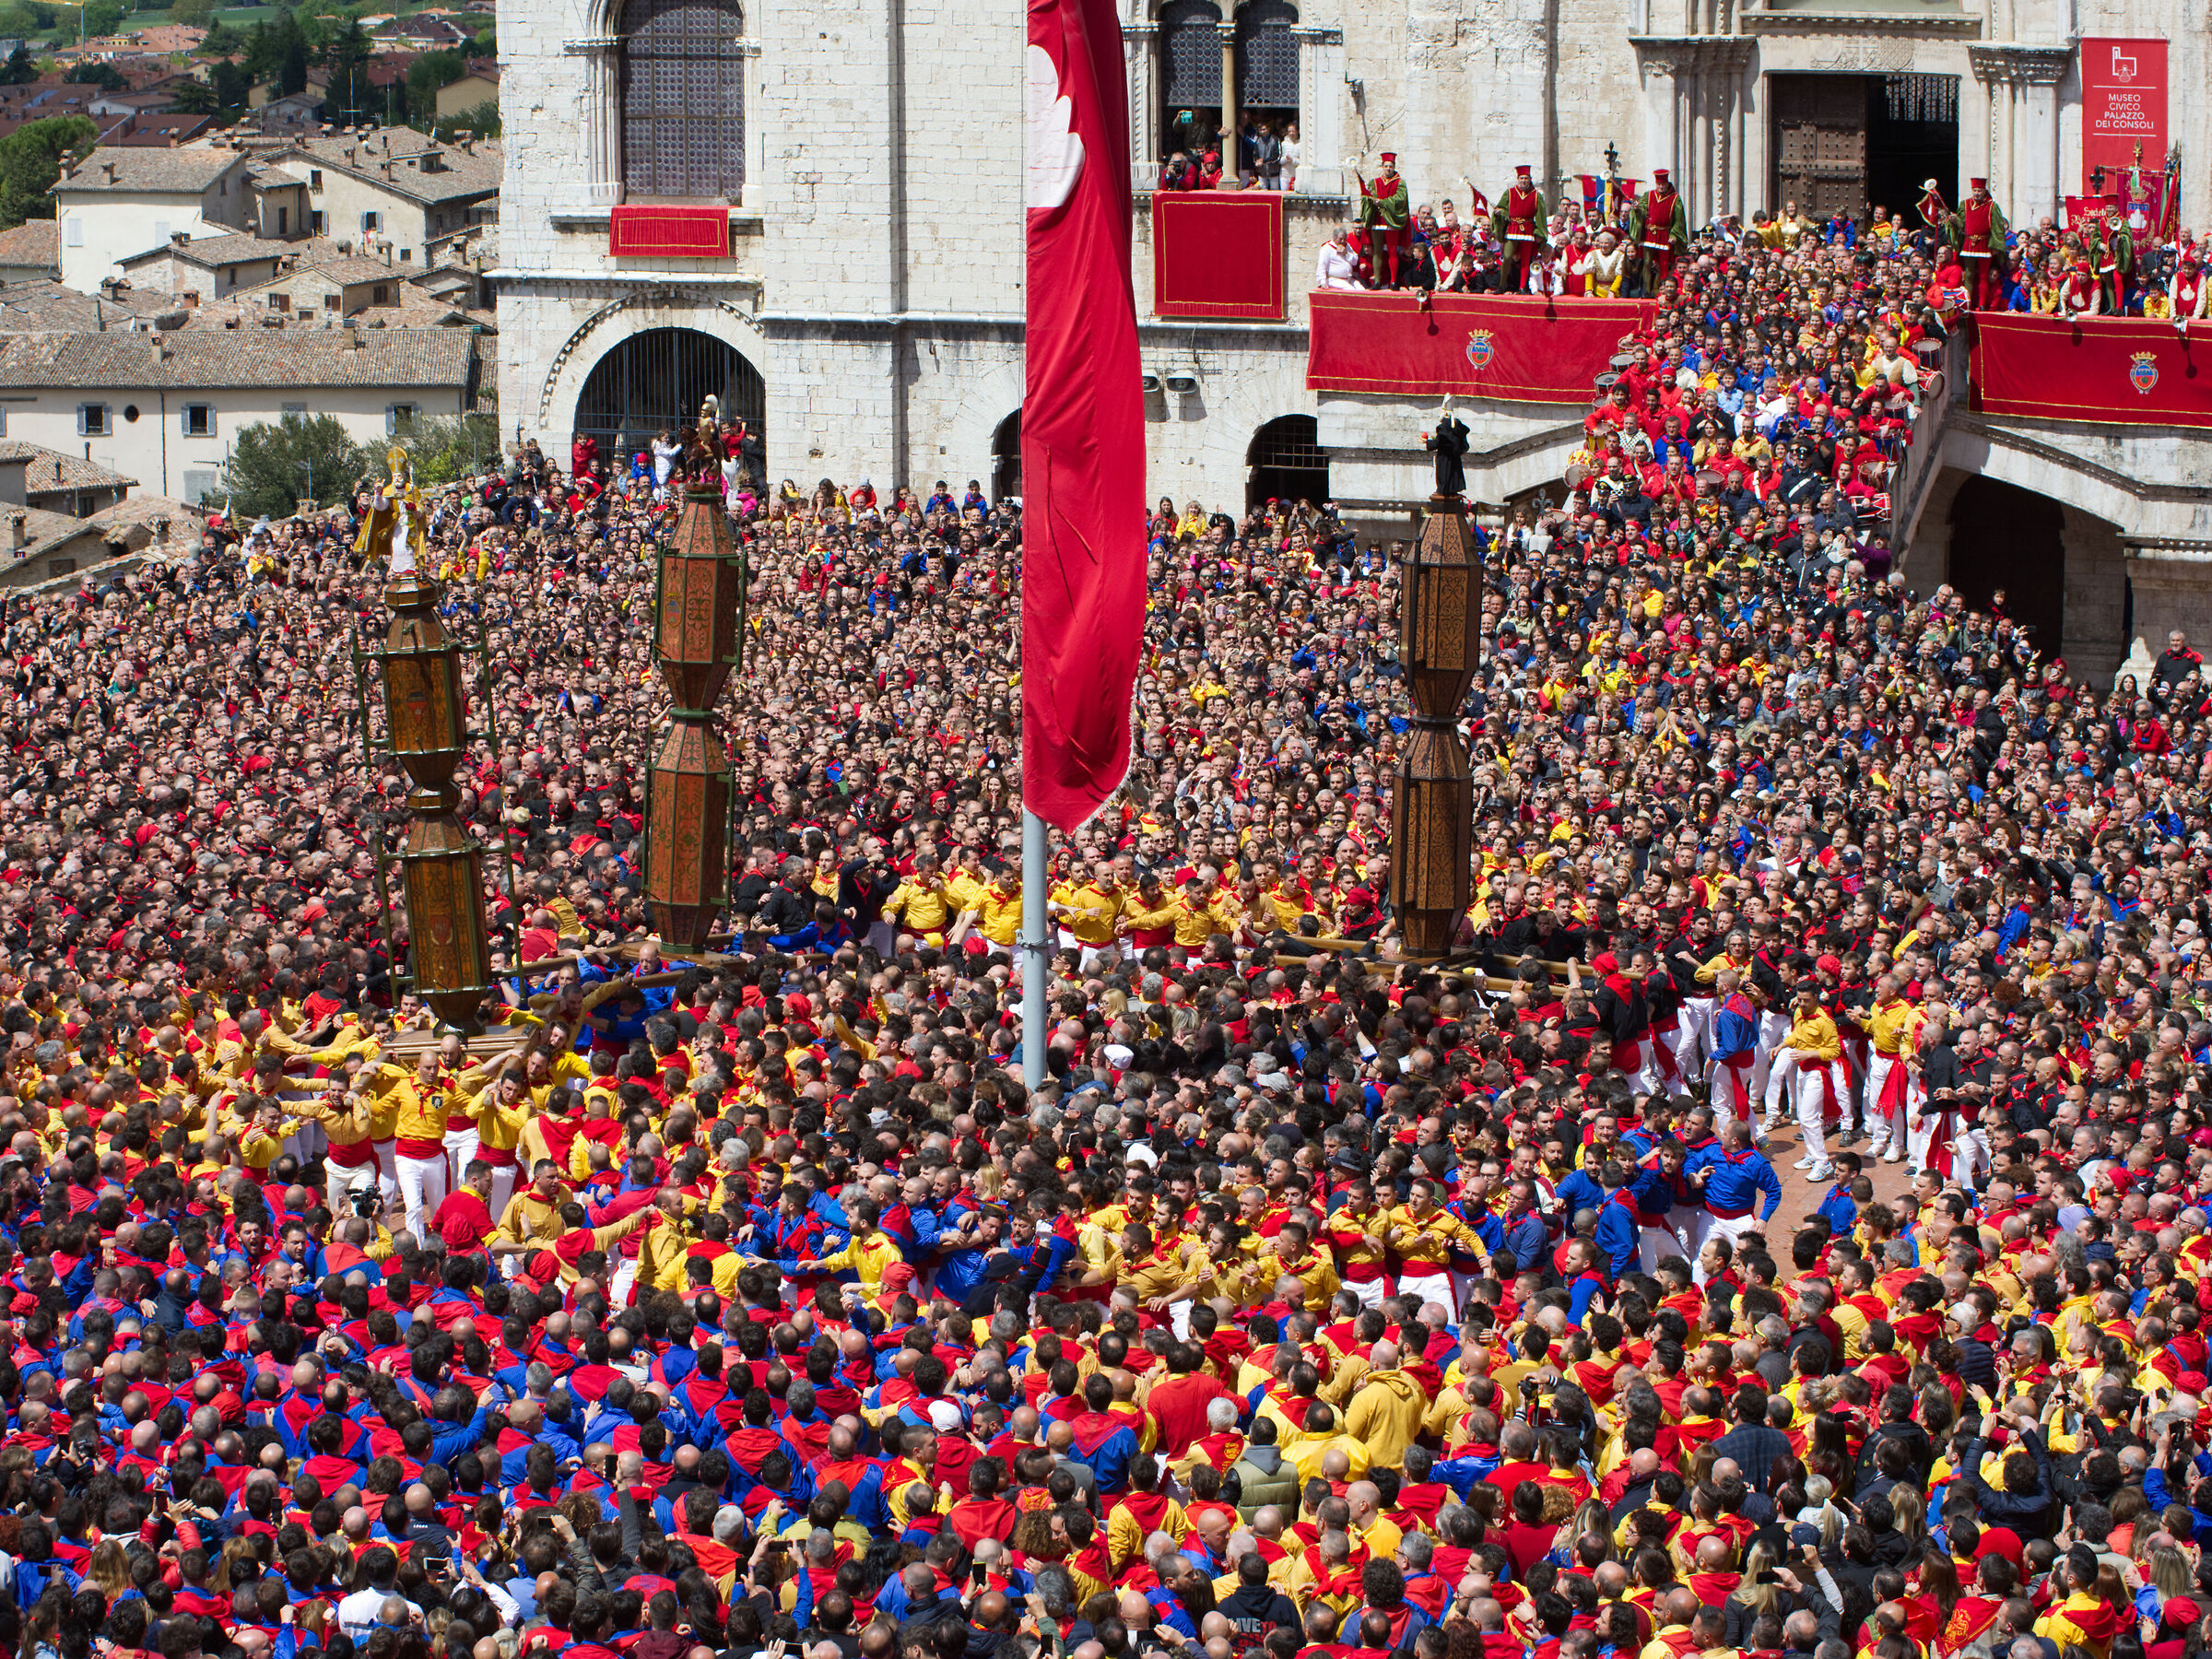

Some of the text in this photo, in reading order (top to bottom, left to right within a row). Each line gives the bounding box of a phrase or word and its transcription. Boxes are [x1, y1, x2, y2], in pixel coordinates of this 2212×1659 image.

[2108, 93, 2141, 102] MUSEO
[2109, 102, 2141, 111] CIVICO
[2104, 111, 2145, 120] PALAZZO
[2095, 120, 2154, 129] DEI CONSOLI
[1233, 1617, 1261, 1633] IVE
